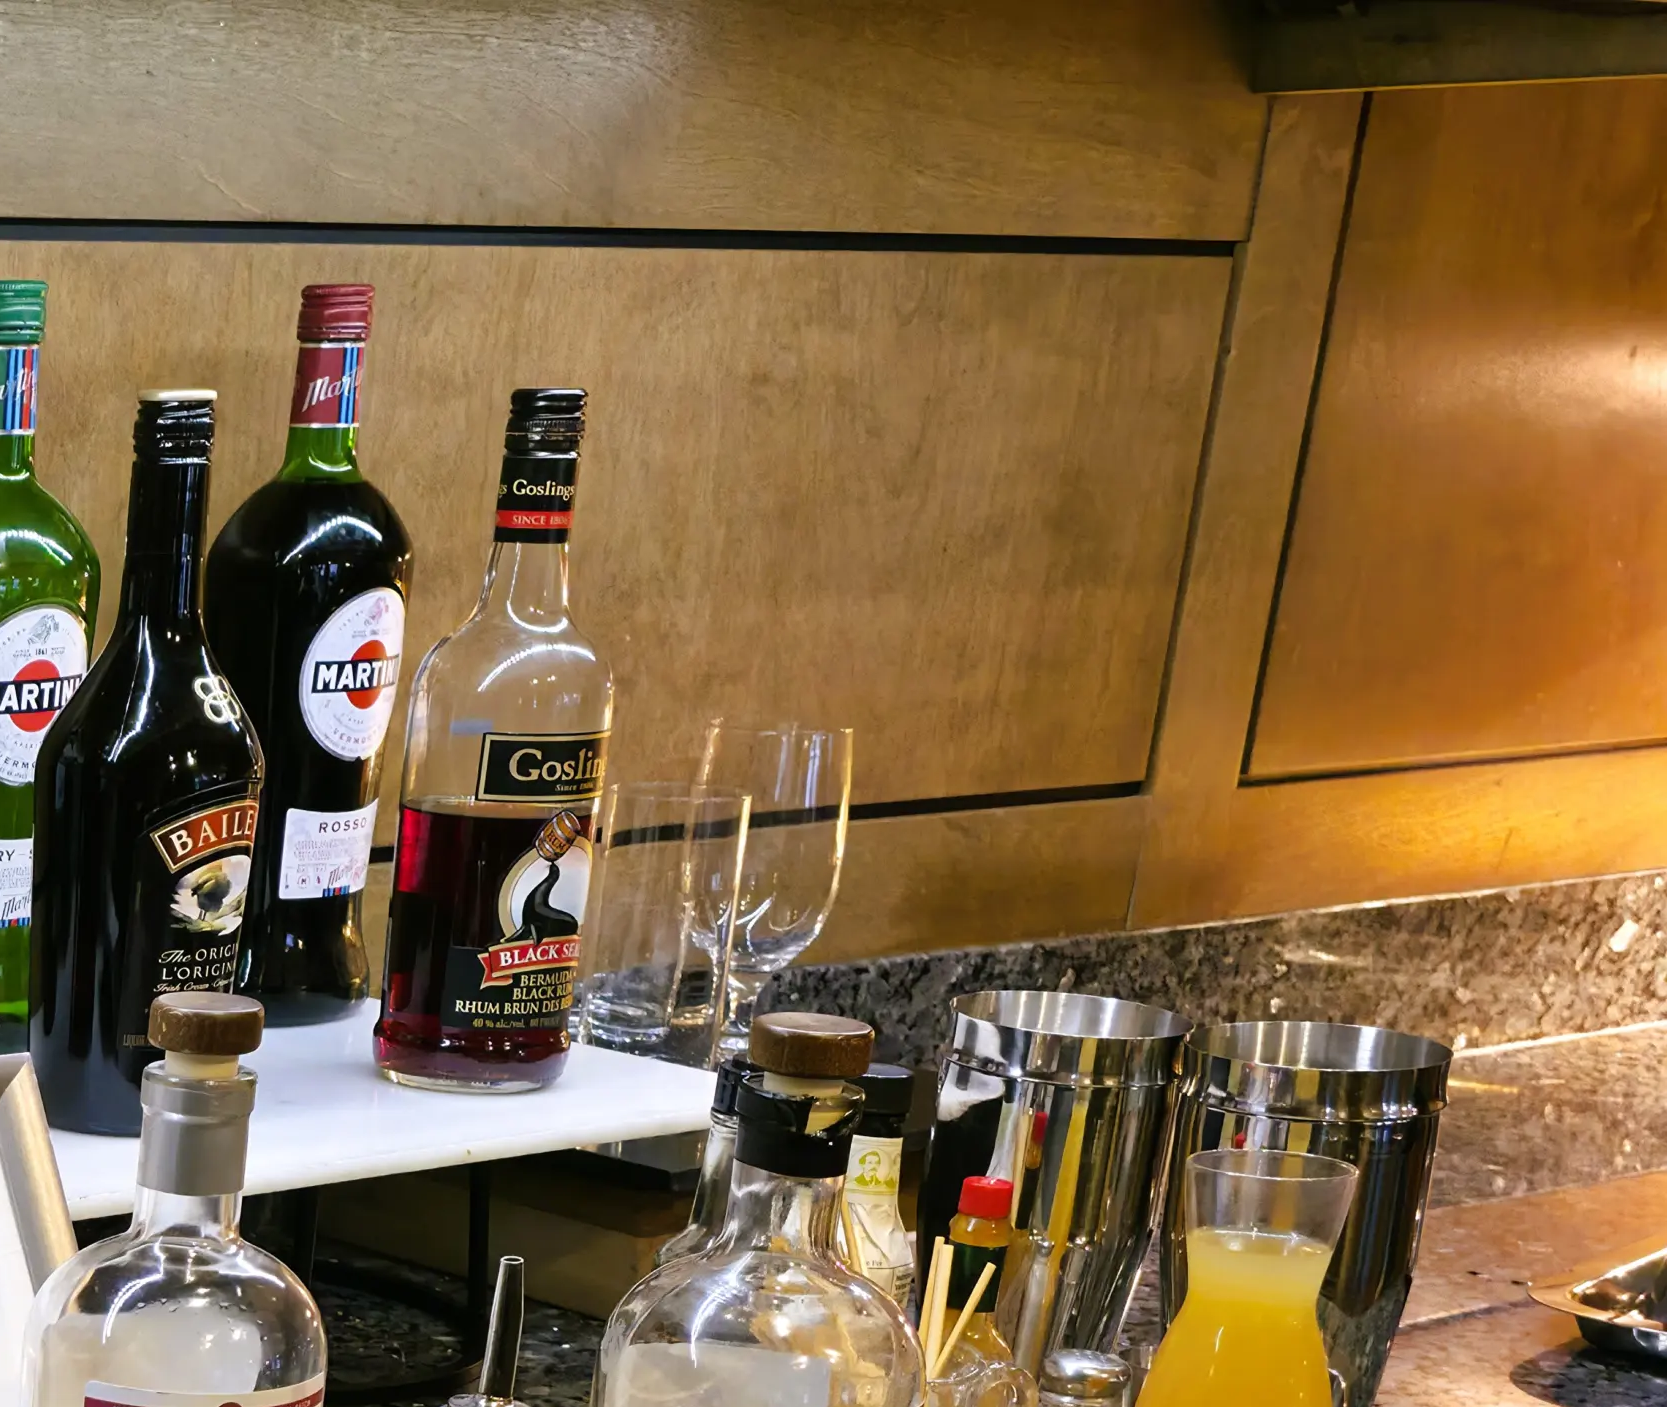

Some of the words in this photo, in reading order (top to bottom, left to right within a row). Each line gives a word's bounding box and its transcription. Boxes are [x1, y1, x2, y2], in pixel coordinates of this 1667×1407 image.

[512, 478, 575, 501] Goslings
[512, 514, 547, 525] SINCE
[319, 817, 367, 833] ROSSO
[169, 809, 255, 857] BAILE
[159, 949, 192, 964] The
[499, 944, 560, 967] BLACK
[512, 986, 556, 1000] BLACK
[455, 1000, 500, 1015] RHUM
[504, 1002, 540, 1015] BRUN
